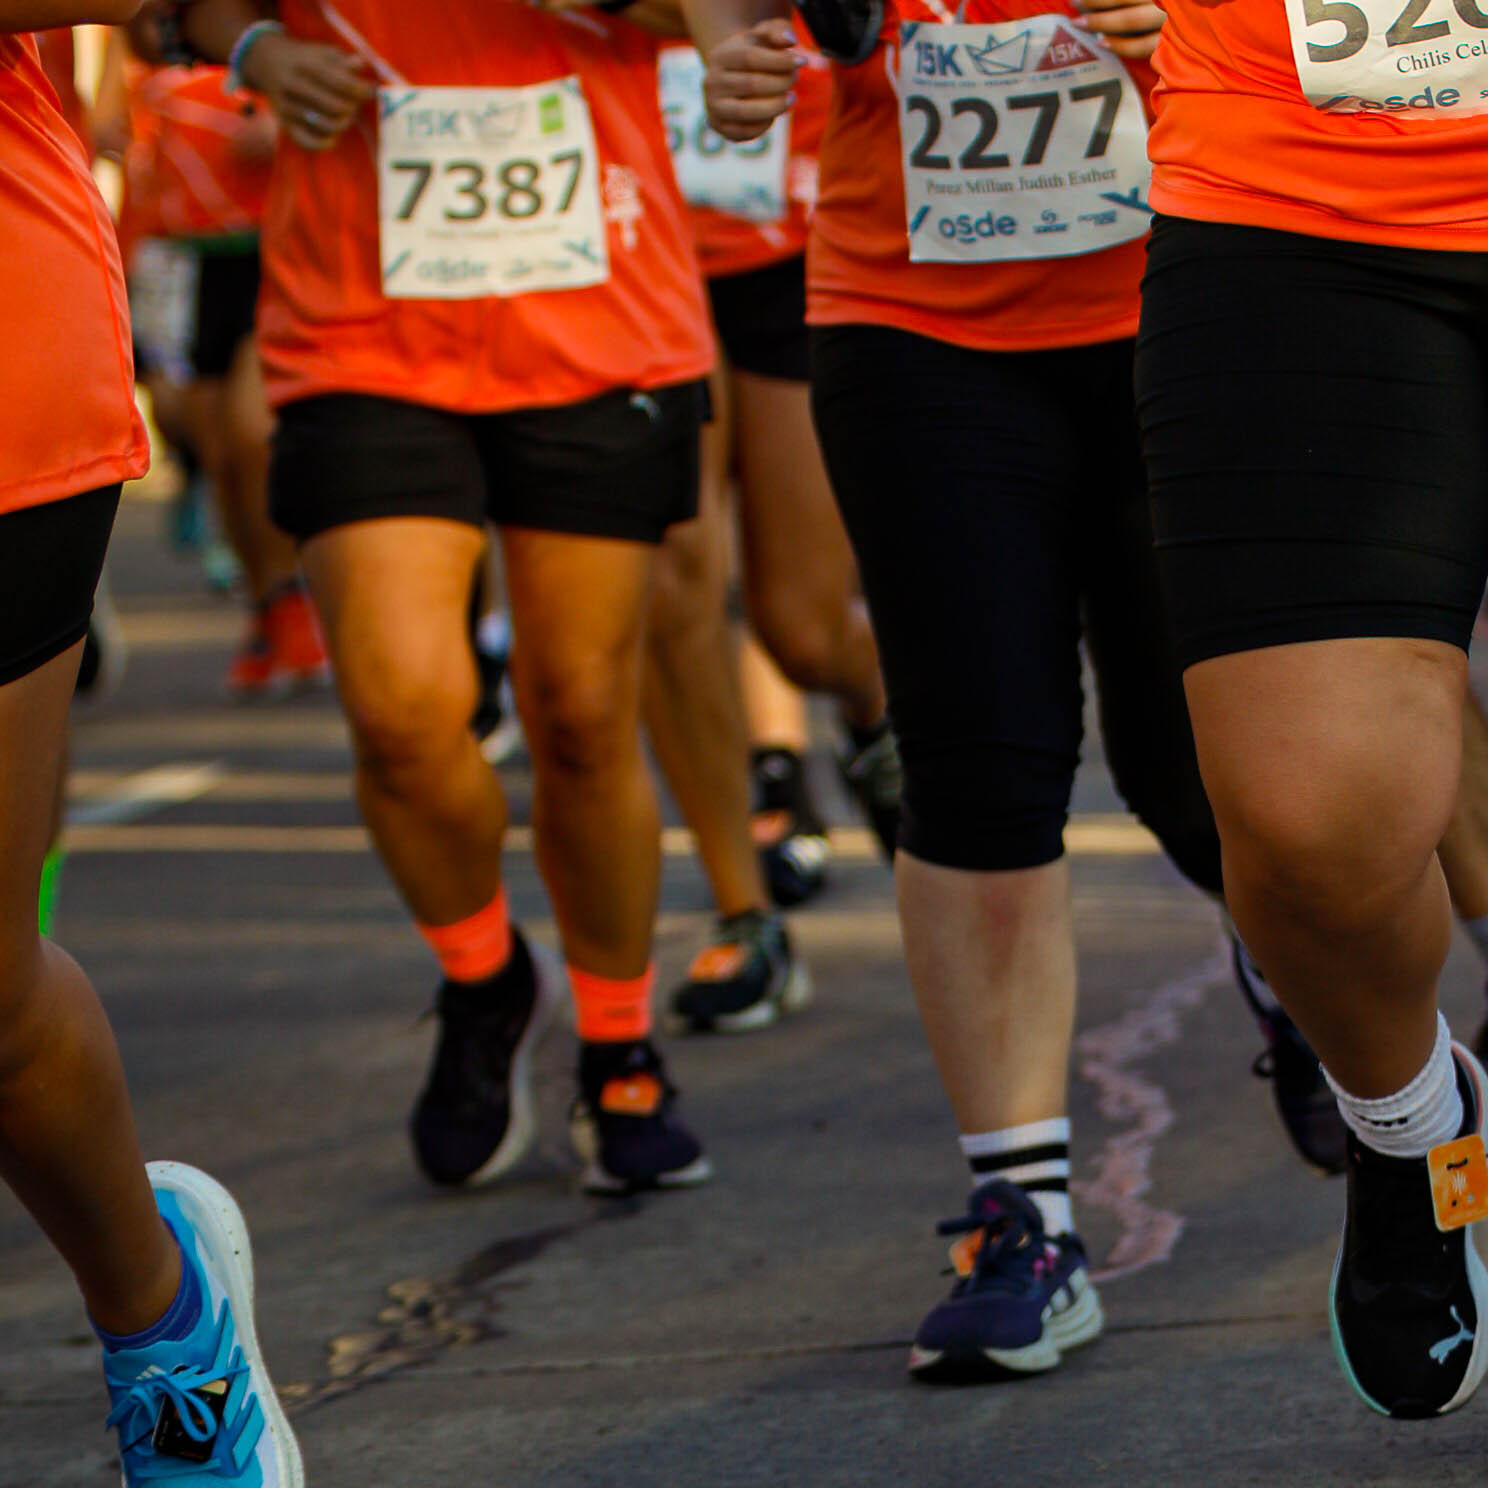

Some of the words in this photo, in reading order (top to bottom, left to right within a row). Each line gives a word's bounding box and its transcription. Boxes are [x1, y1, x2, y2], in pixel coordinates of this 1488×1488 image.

[913, 41, 964, 77] 15K
[1050, 42, 1084, 65] 15K
[1397, 49, 1451, 73] Chilis
[906, 78, 1123, 170] 2277
[390, 148, 583, 221] 7387
[1068, 168, 1118, 186] Esther
[938, 211, 1017, 242] osde
